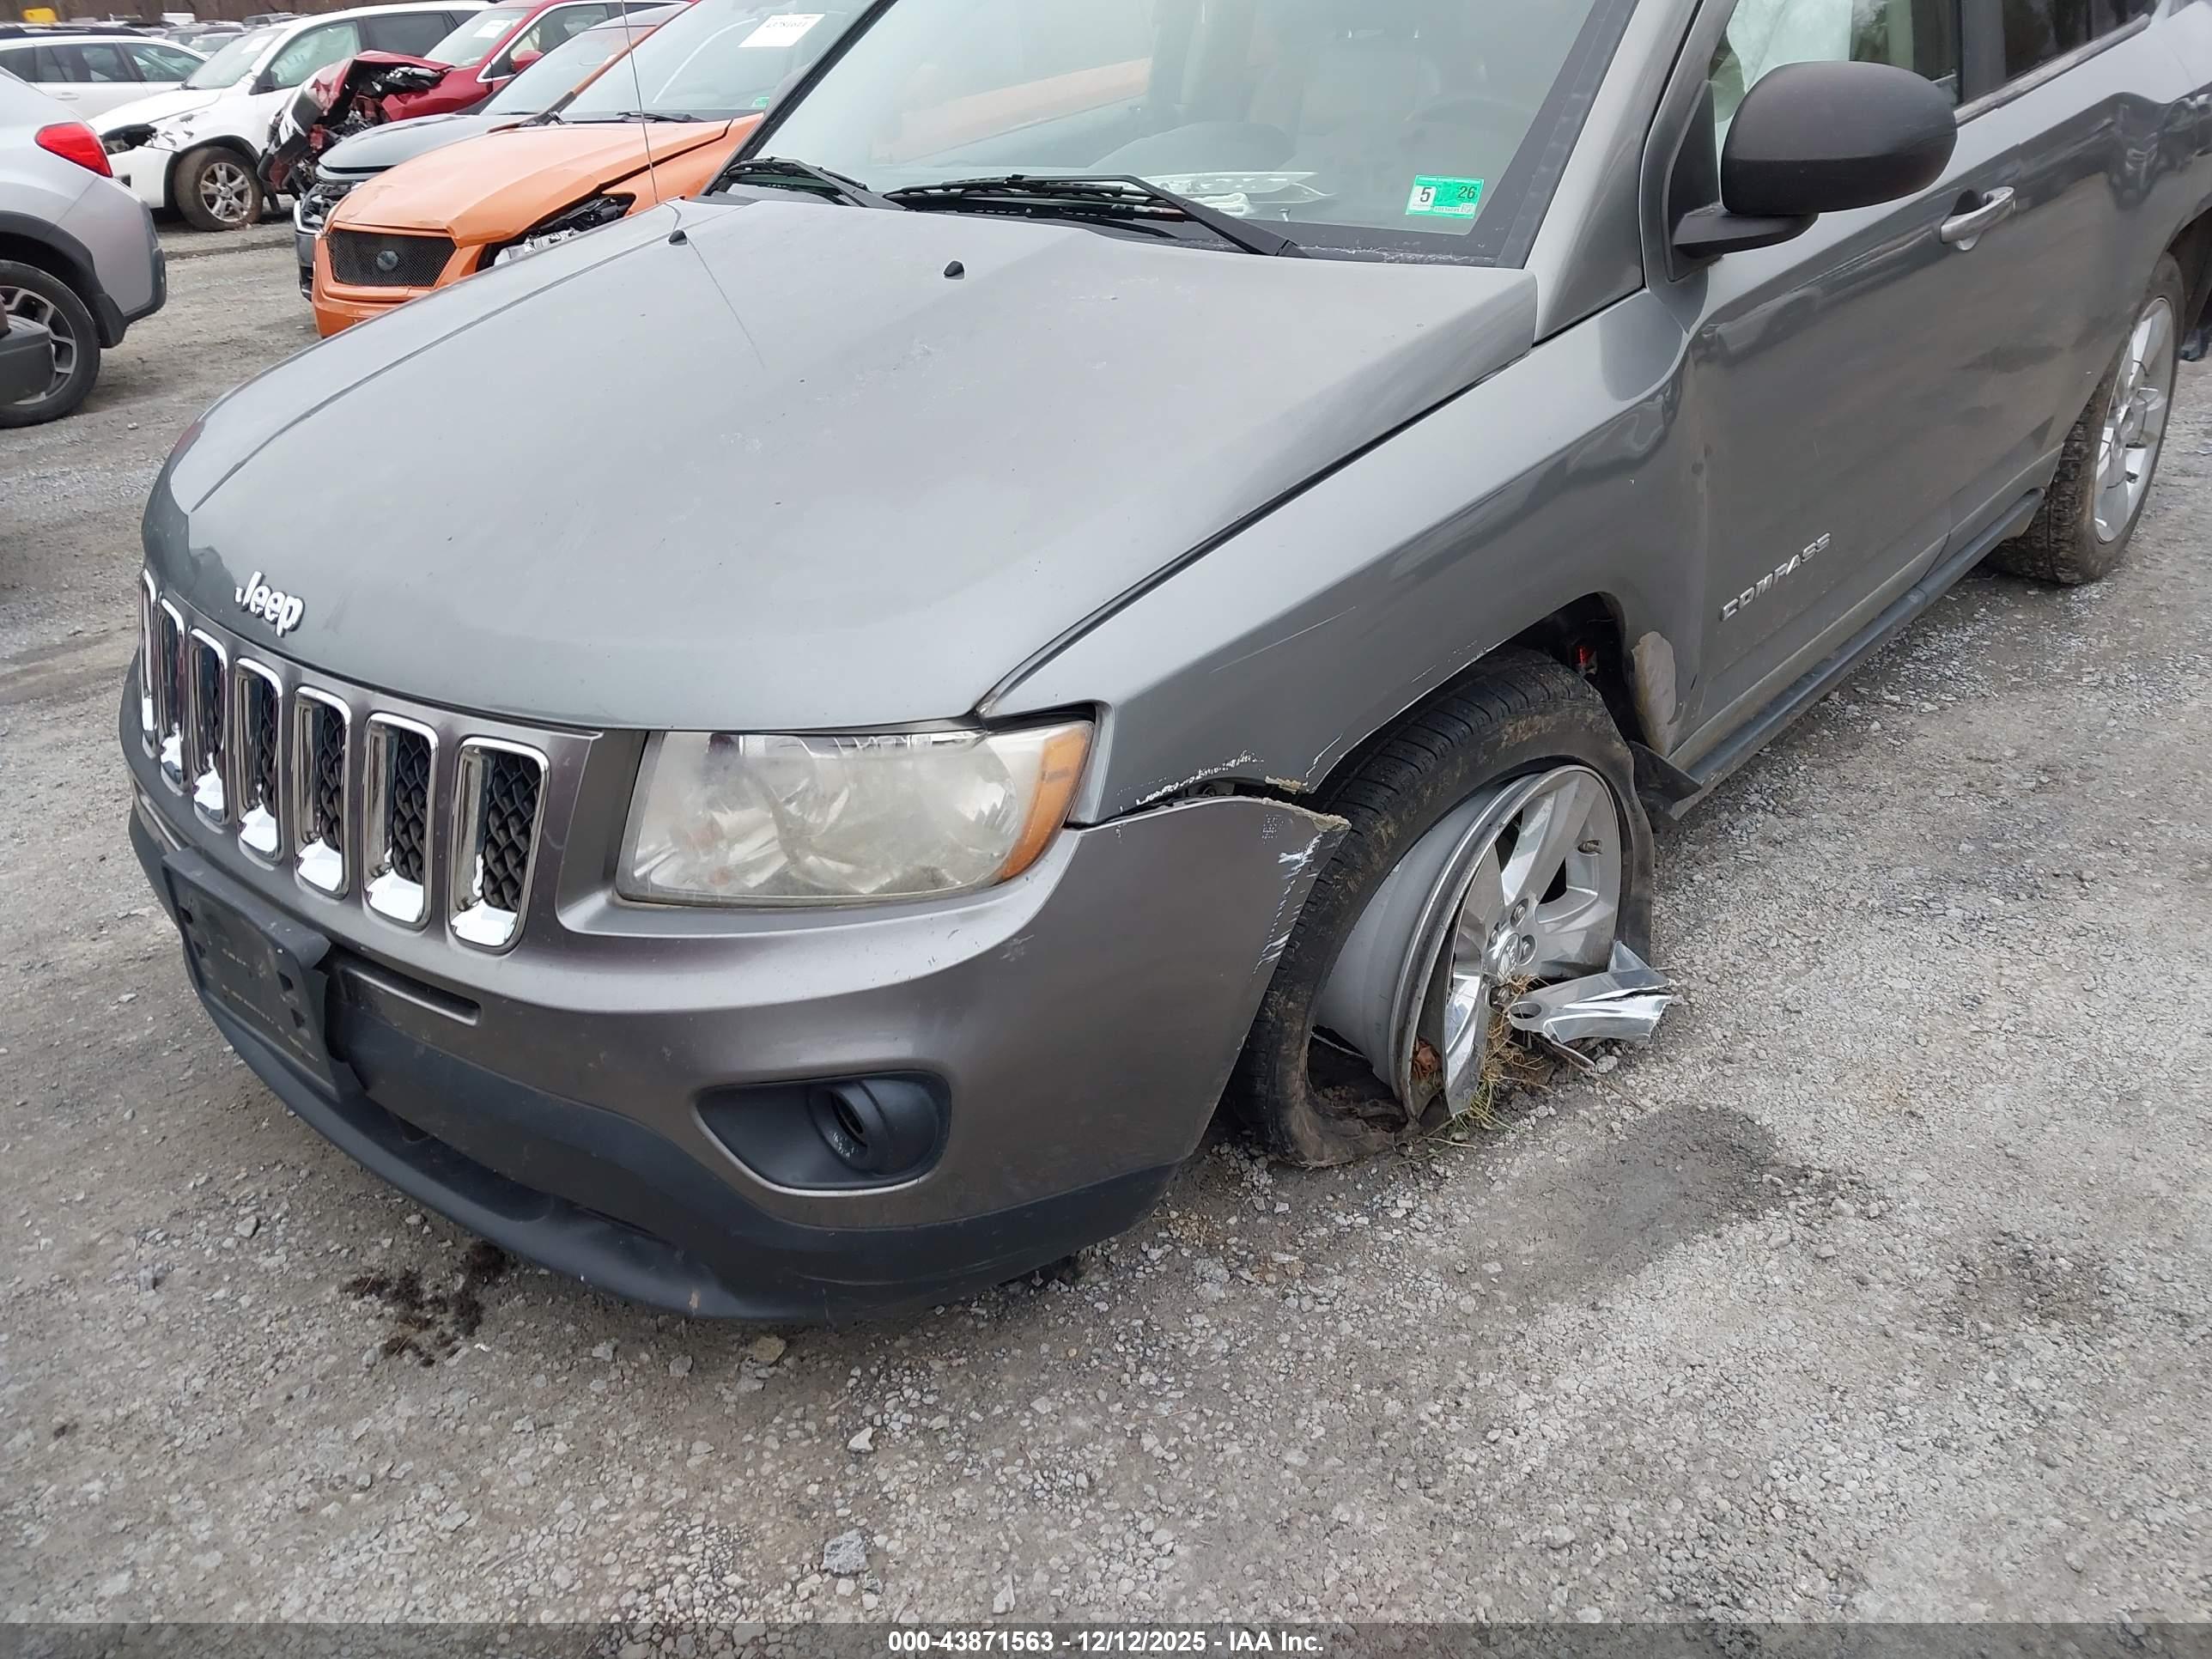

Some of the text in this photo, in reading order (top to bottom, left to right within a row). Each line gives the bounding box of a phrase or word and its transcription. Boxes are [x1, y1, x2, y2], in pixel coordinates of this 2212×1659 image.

[1419, 185, 1478, 203] 5 26
[234, 570, 304, 637] Jeep
[1722, 532, 1831, 622] COMPASS
